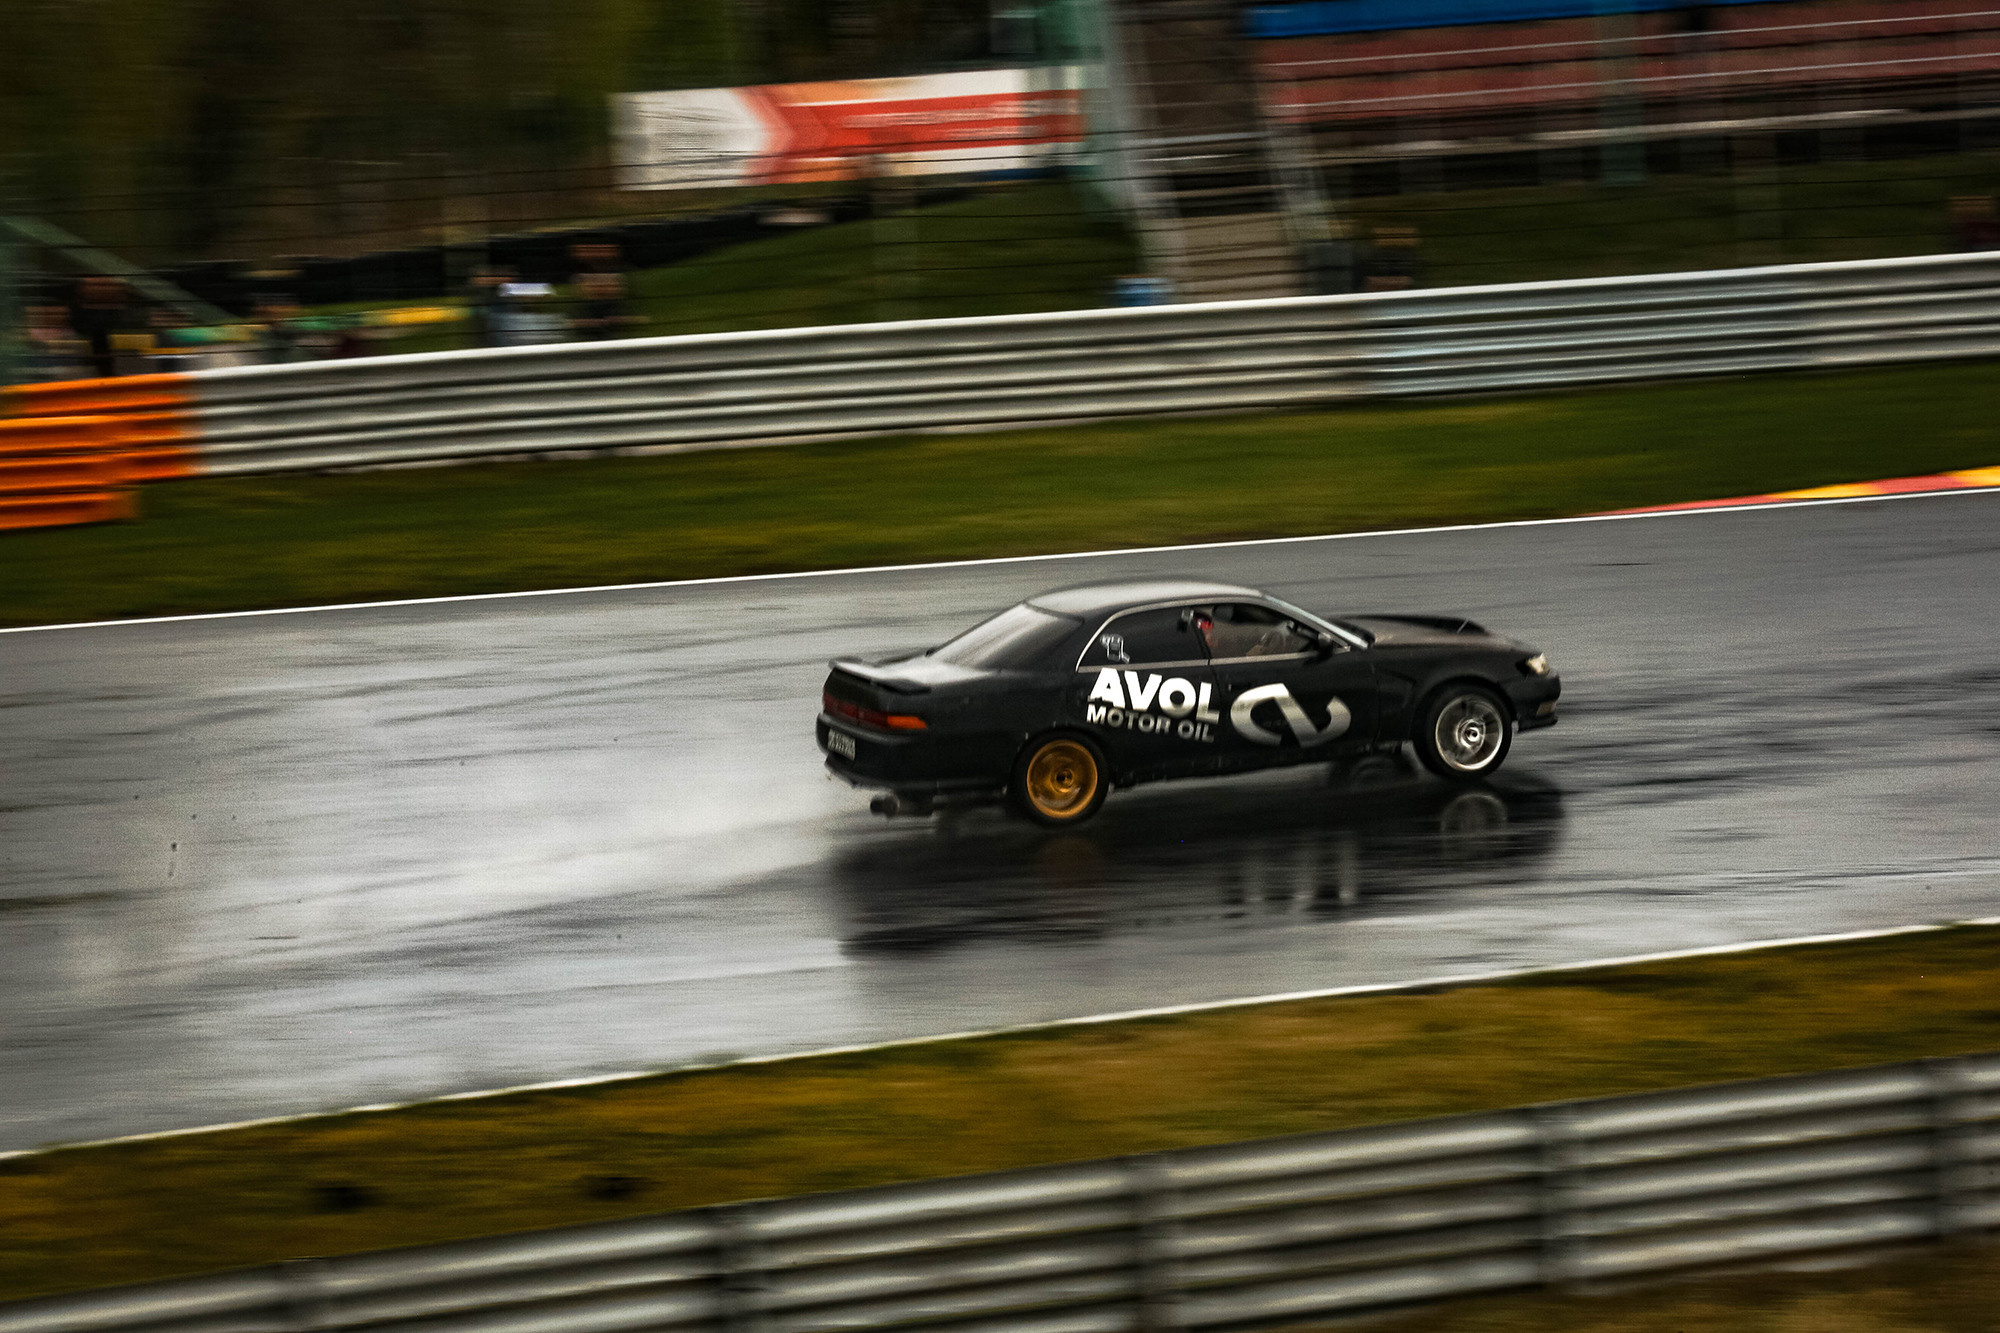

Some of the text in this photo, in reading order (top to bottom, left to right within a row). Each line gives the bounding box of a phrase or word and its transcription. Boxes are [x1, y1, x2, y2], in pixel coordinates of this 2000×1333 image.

[1087, 667, 1220, 724] AVOL
[1086, 704, 1214, 742] MOTOR OIL
